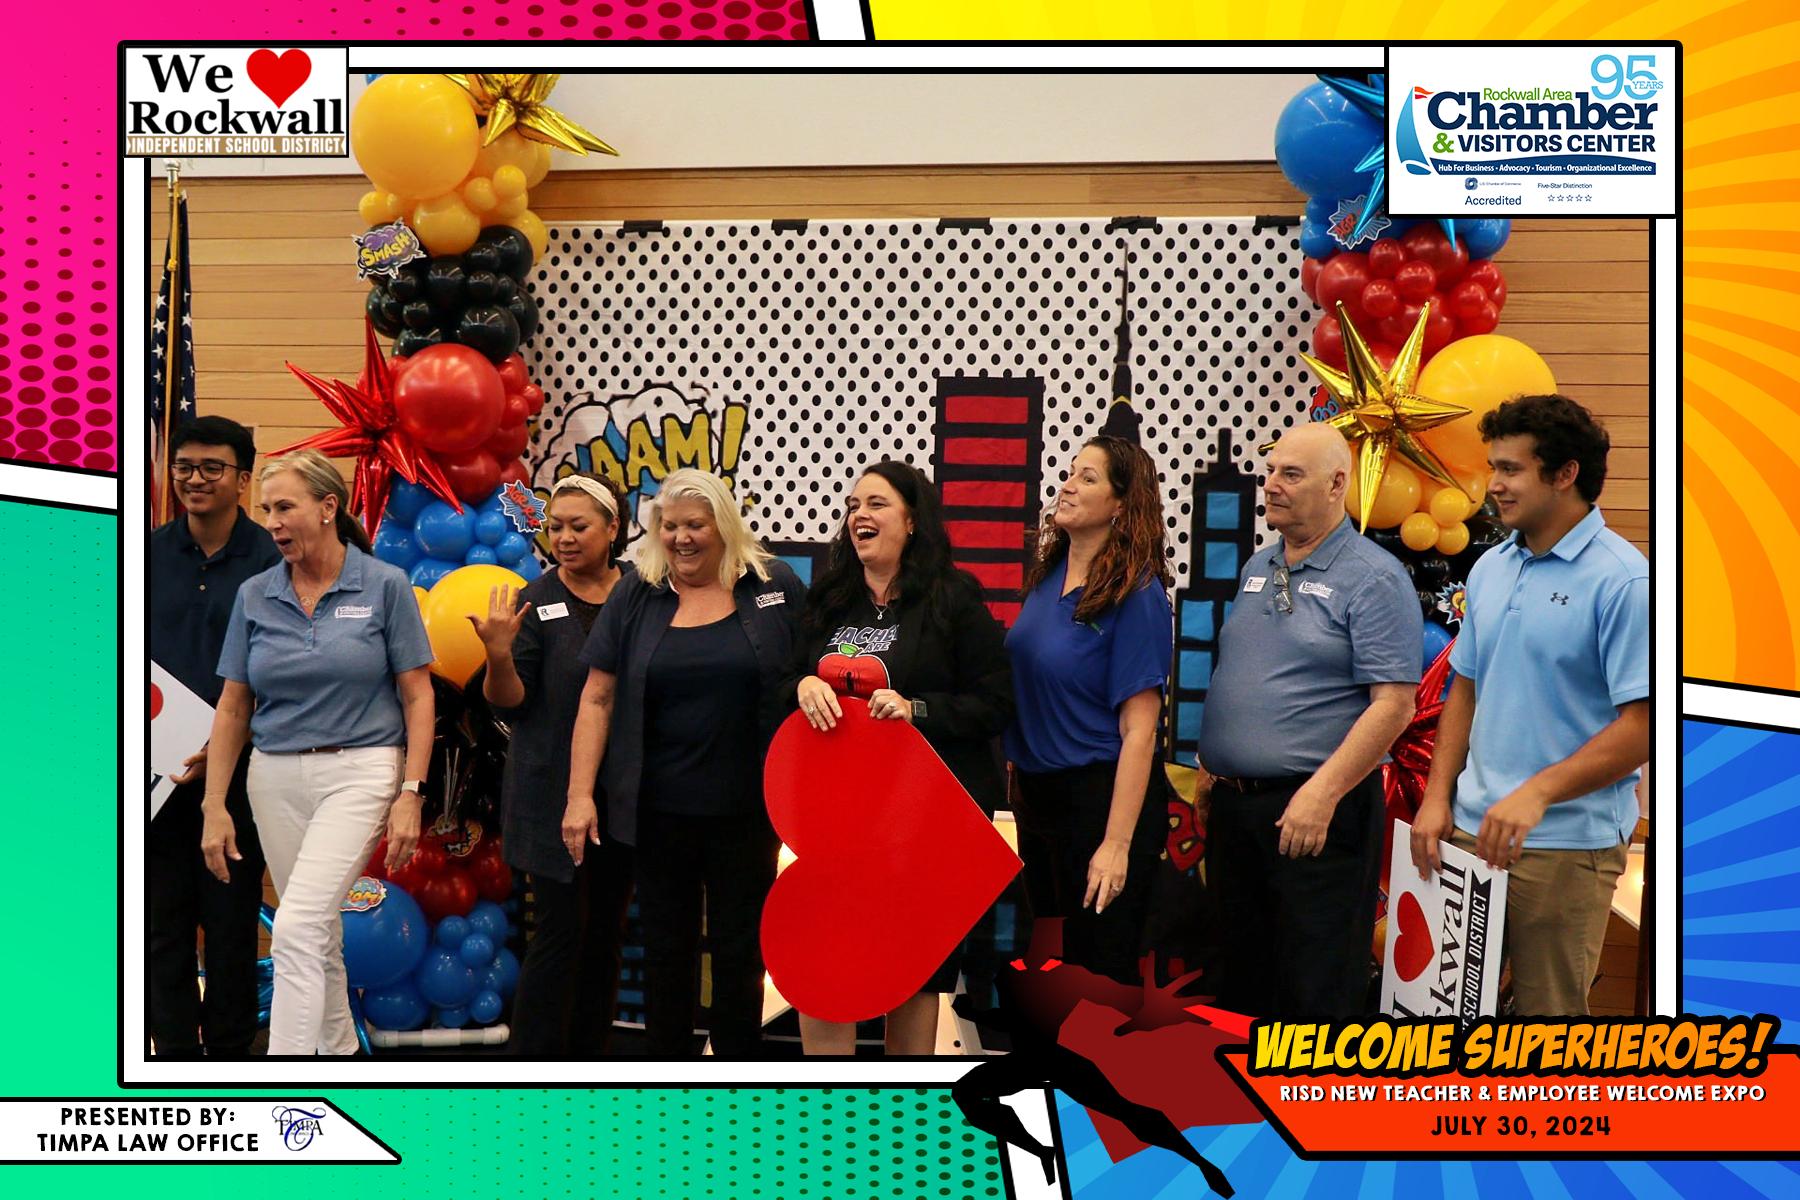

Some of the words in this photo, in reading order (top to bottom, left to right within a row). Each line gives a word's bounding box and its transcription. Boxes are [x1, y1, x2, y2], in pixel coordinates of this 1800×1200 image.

[361, 232, 410, 267] SMASH
[1430, 860, 1467, 1018] kwall
[1468, 890, 1487, 959] DISTRICT
[1463, 962, 1480, 1020] SCHOOL
